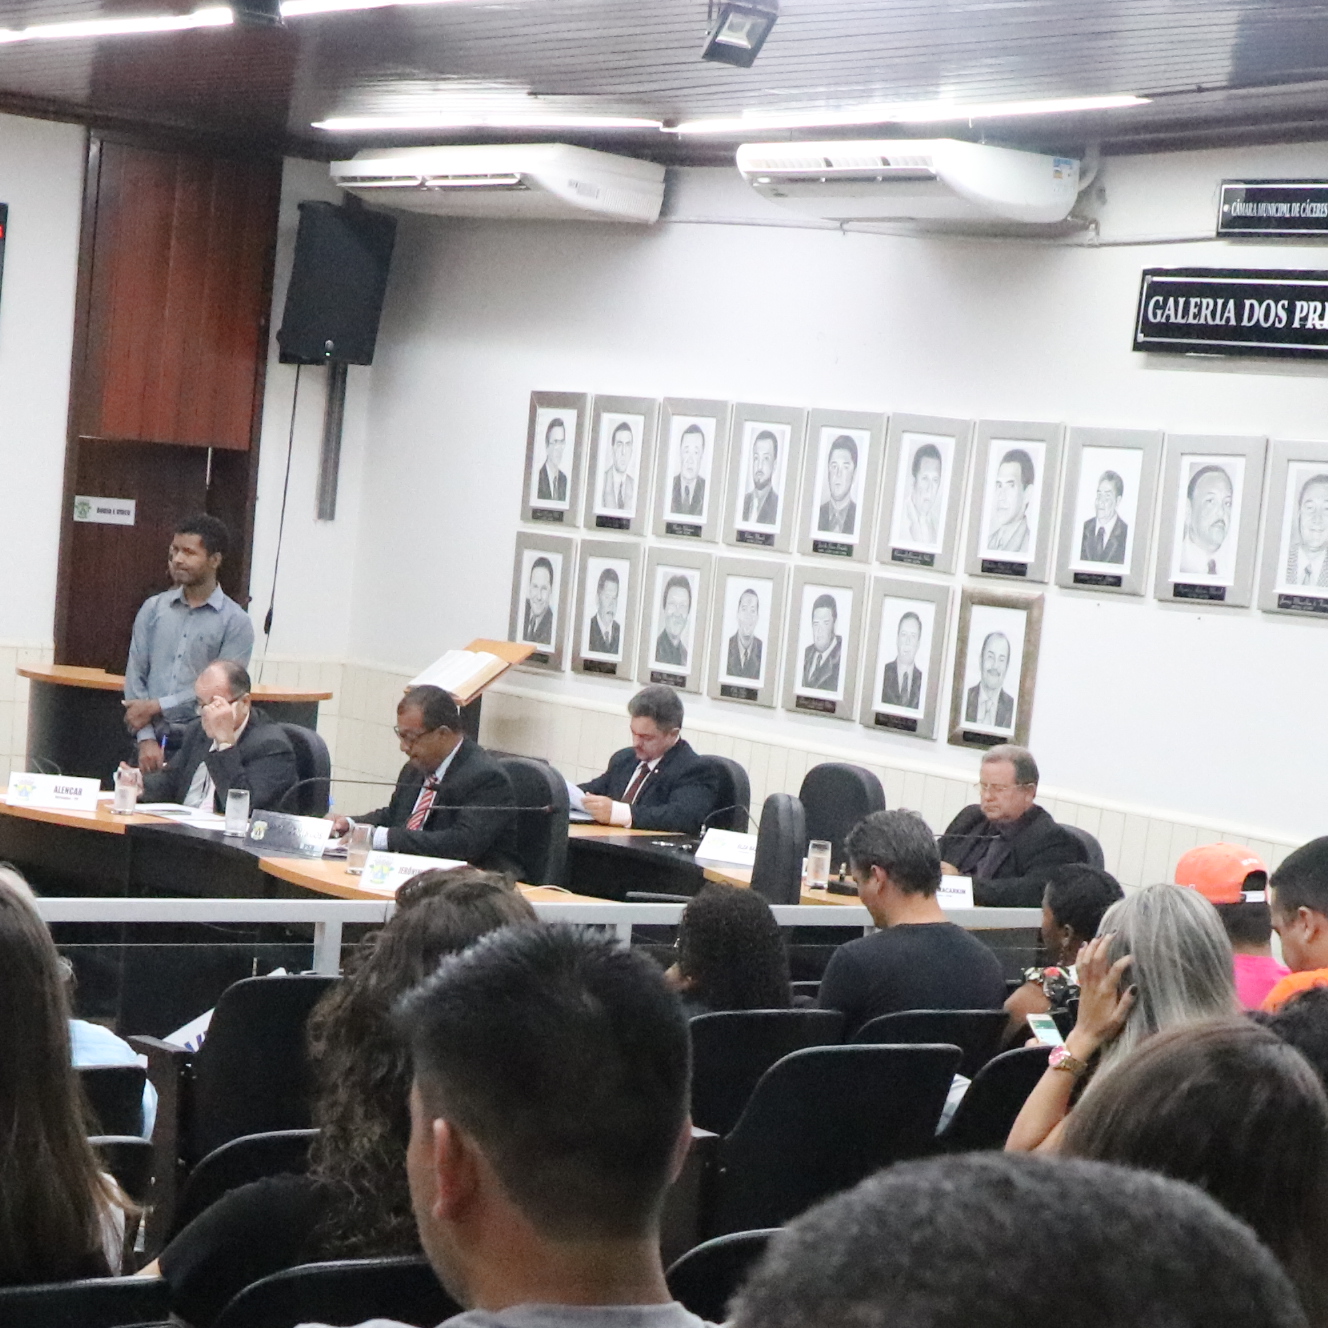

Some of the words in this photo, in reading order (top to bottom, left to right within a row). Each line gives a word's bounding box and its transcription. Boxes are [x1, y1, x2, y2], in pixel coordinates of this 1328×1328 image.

[1258, 202, 1290, 217] MUNICIPAL
[1291, 203, 1300, 217] DE
[1301, 198, 1328, 217] CÁCERES
[1147, 296, 1236, 327] GALERIA
[1241, 299, 1288, 329] DOS
[53, 785, 83, 796] ALENCAR
